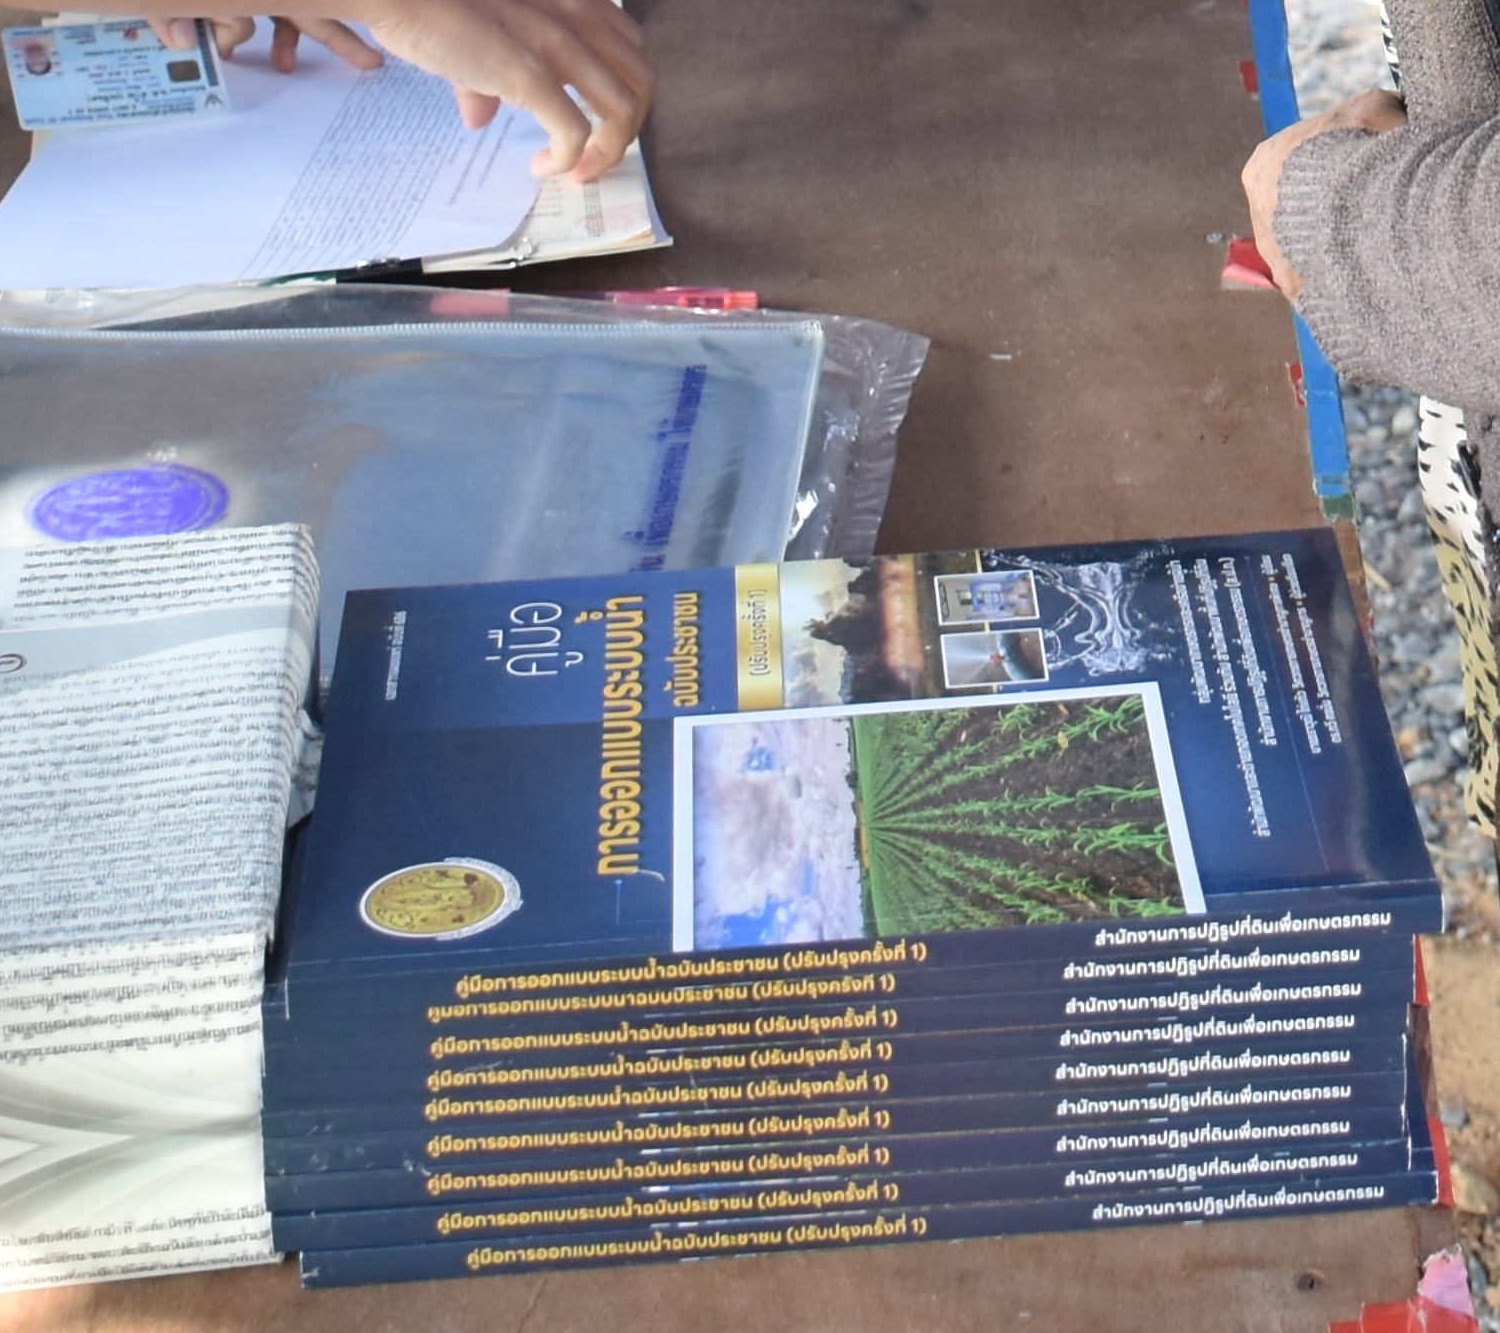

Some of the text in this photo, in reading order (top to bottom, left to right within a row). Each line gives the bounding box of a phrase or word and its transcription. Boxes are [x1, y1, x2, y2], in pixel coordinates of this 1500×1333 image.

[485, 601, 585, 677] คู่มือ
[662, 591, 702, 707] ฉบับประชาชน
[740, 600, 775, 676] (ปรับปรุงครั้งที่
[577, 594, 646, 876] การออกแบบระบบน้ำ
[1094, 910, 1392, 947] สำนักงานการปฏิรูปที่ดินเพื่อเกษตรกรรม
[457, 942, 926, 998] คู่มือการออกแบบระบบน้ำฉบับประชาชน (ปรับปรุงครั้งที่ 1)
[879, 976, 895, 992] 1)
[1062, 946, 1361, 980] สำนักงานการปฏิรูปที่ดินเพื่อเกษตรกรรม
[1064, 981, 1362, 1015] สำนักงานการปฏิรูปที่ดินเพื่อเกษตรกรรม
[431, 1009, 897, 1058] คู่มือการออกแบบระบบน้ำฉบับประชาชน (ปรับปรุงครั้งที่ 1)
[1059, 1012, 1356, 1048] สำนักงานการปฏิรูปที่ดินเพื่อเกษตรกรรม
[427, 1041, 892, 1091] คู่มือการออกแบบระบบน้ำฉบับประชาชน (ปรับปรุงครั้งที่ 1)
[1054, 1047, 1351, 1081] สำนักงานการปฏิรูปที่ดินเพื่อเกษตรกรรม
[425, 1073, 889, 1120] คู่มือการออกแบบระบบน้ำฉบับประชาชน (ปรับปรุงครั้งที่ 1)
[1056, 1083, 1352, 1117] สำนักงานการปฏิรูปที่ดินเพื่อเกษตรกรรม
[427, 1109, 890, 1157] คู่มือการออกแบบระบบน้ำฉบับประชาชน (ปรับปรุงครั้งที่ 1)
[1055, 1119, 1351, 1153] สำนักงานการปฏิรูปที่ดินเพื่อเกษตรกรรม
[427, 1147, 889, 1195] คู่มือการออกแบบระบบน้ำฉบับประชาชน (ปรับปรุงครั้งที่ 1)
[1064, 1152, 1358, 1188] สำนักงานการปฏิรูปที่ดินเพื่อเกษตรกรรม
[437, 1183, 898, 1234] คู่มือการออกแบบระบบน้ำฉบับประชาชน (ปรับปรุงครั้งที่ 1)
[1091, 1183, 1385, 1221] สำนักงานการปฏิรูปที่ดินเพื่อเกษตรกรรม
[467, 1218, 926, 1268] คู่มือการออกแบบระบบน้ำฉบับประชาชน (ปรับปรุงครั้งที่ 1)
